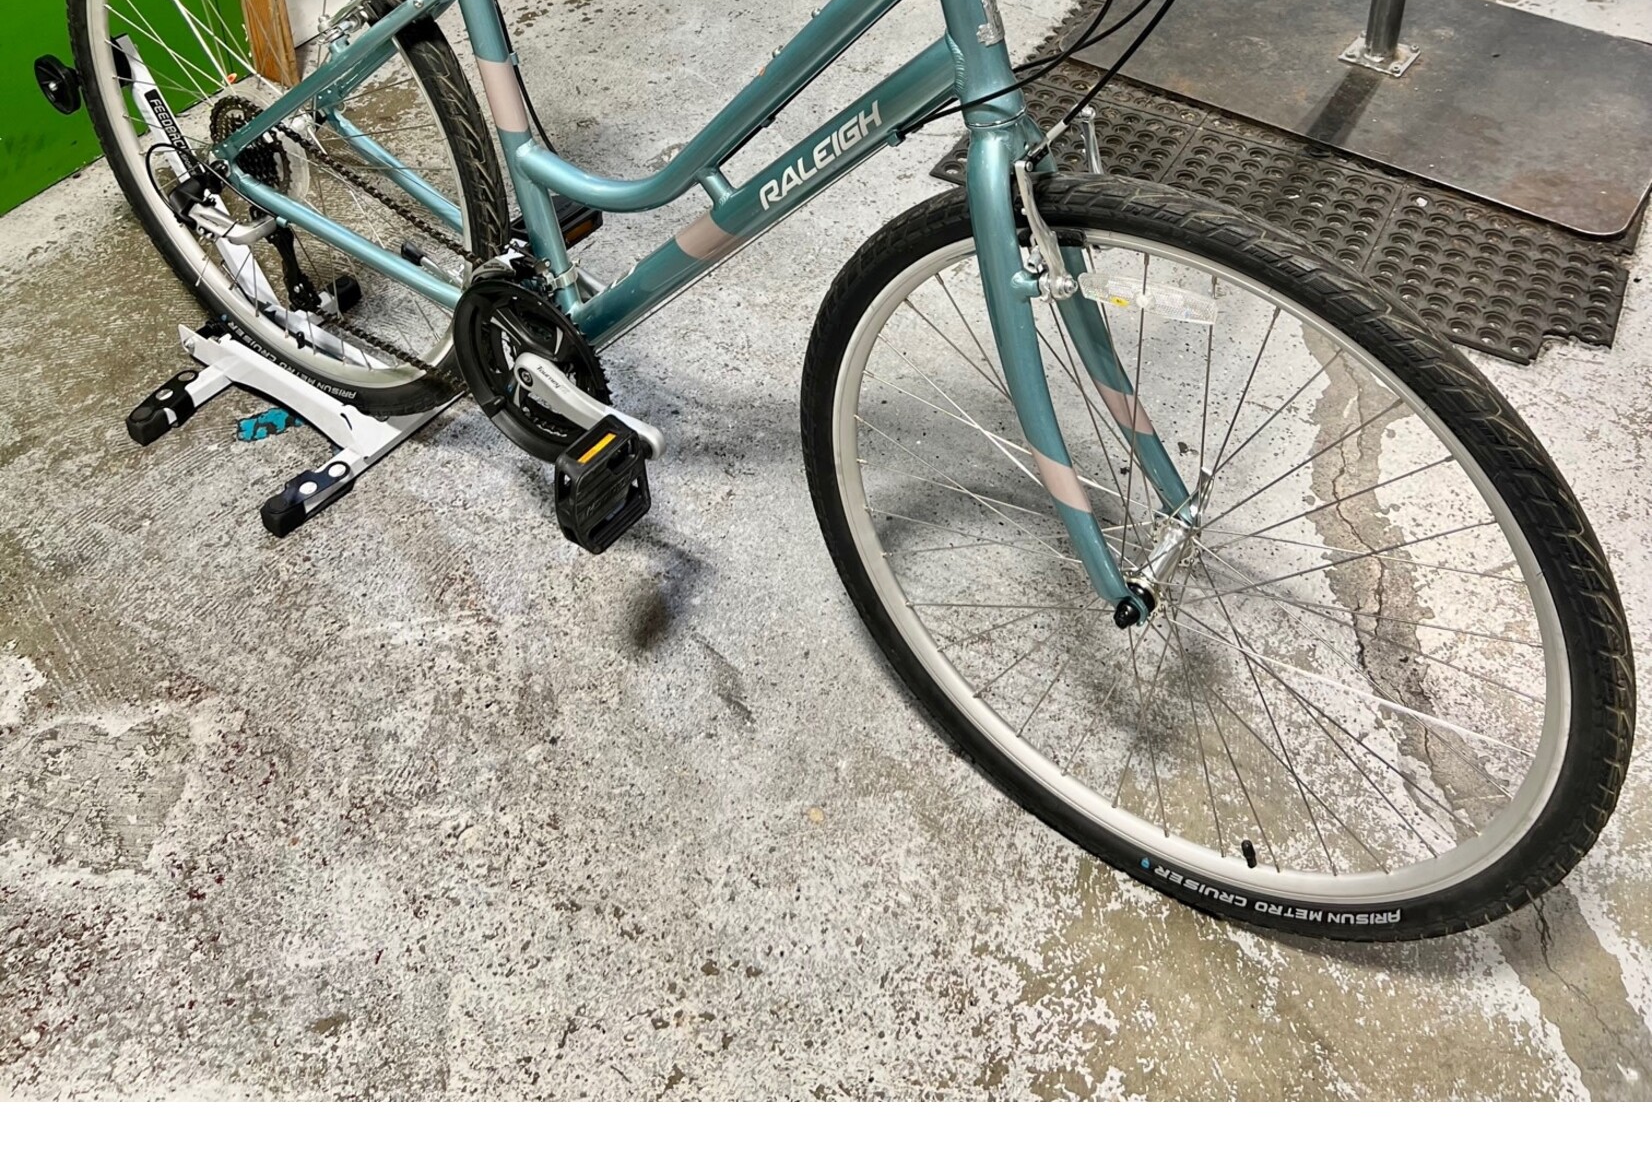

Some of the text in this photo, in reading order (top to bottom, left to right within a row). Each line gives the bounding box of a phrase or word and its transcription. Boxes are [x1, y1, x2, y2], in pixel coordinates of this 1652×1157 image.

[760, 100, 882, 211] RALEIGH
[227, 321, 277, 364] CRUISER
[316, 382, 357, 400] ARISUN
[1154, 864, 1401, 925] ARISUN METRO CRUISER
